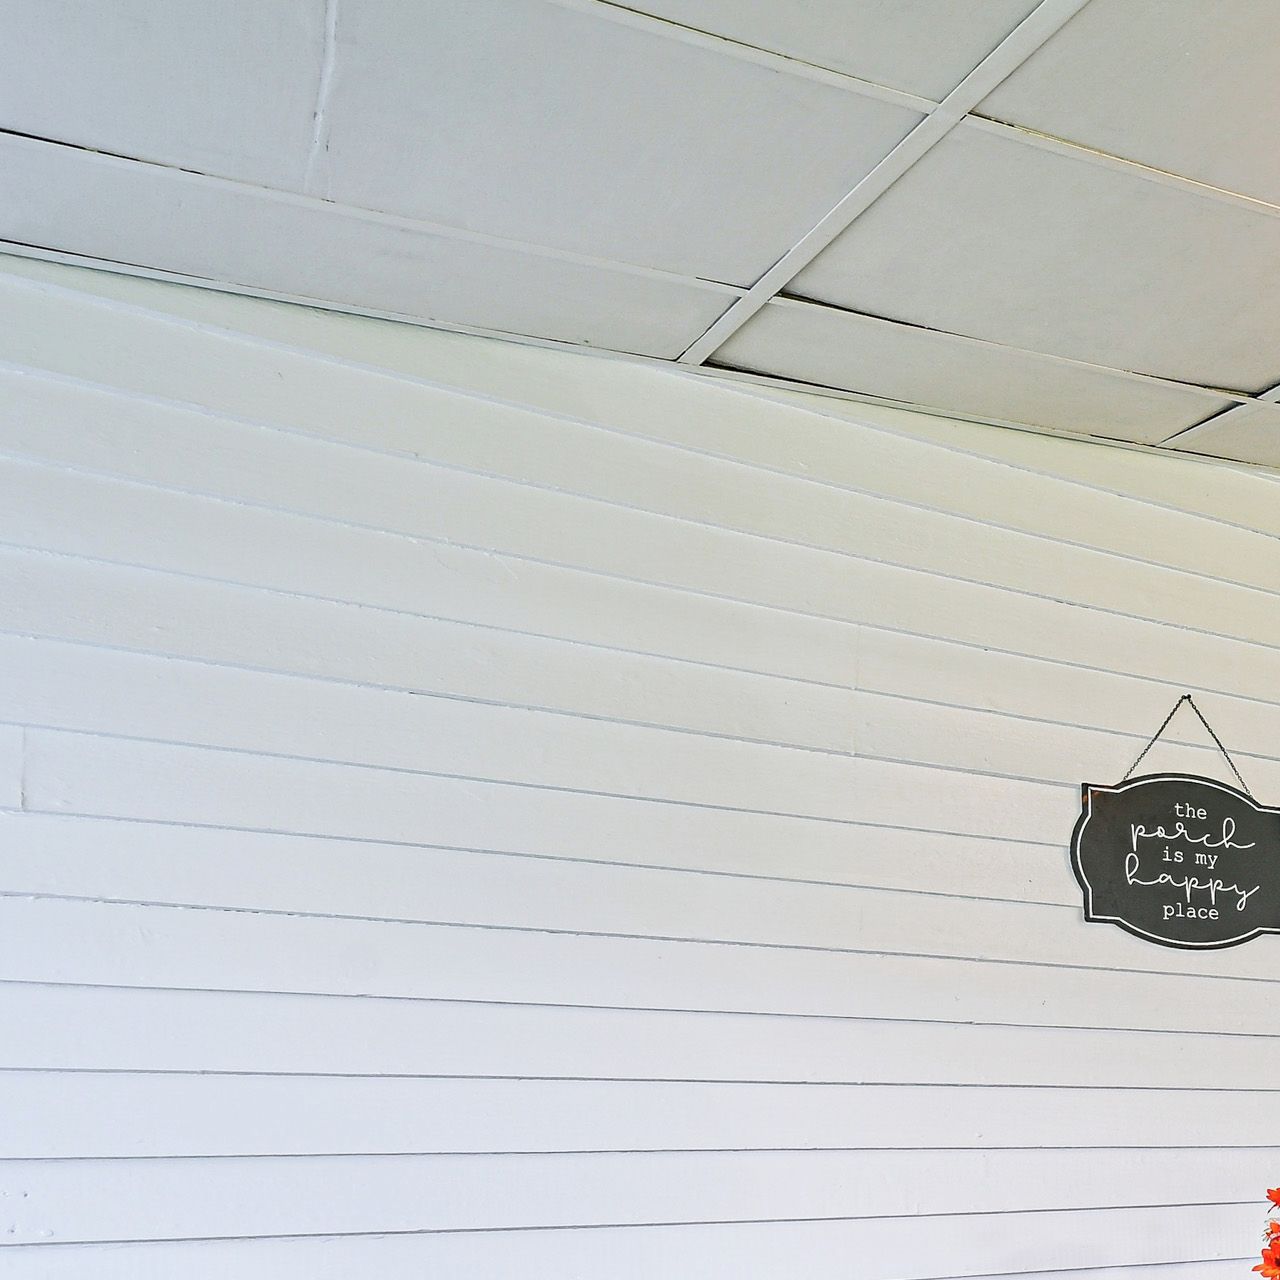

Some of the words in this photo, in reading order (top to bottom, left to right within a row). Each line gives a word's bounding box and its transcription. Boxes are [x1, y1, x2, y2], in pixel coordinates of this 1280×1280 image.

[1174, 802, 1208, 820] the
[1131, 817, 1256, 852] porch
[1162, 845, 1184, 863] is
[1195, 852, 1219, 870] my
[1125, 852, 1261, 912] happy
[1162, 902, 1220, 921] place
